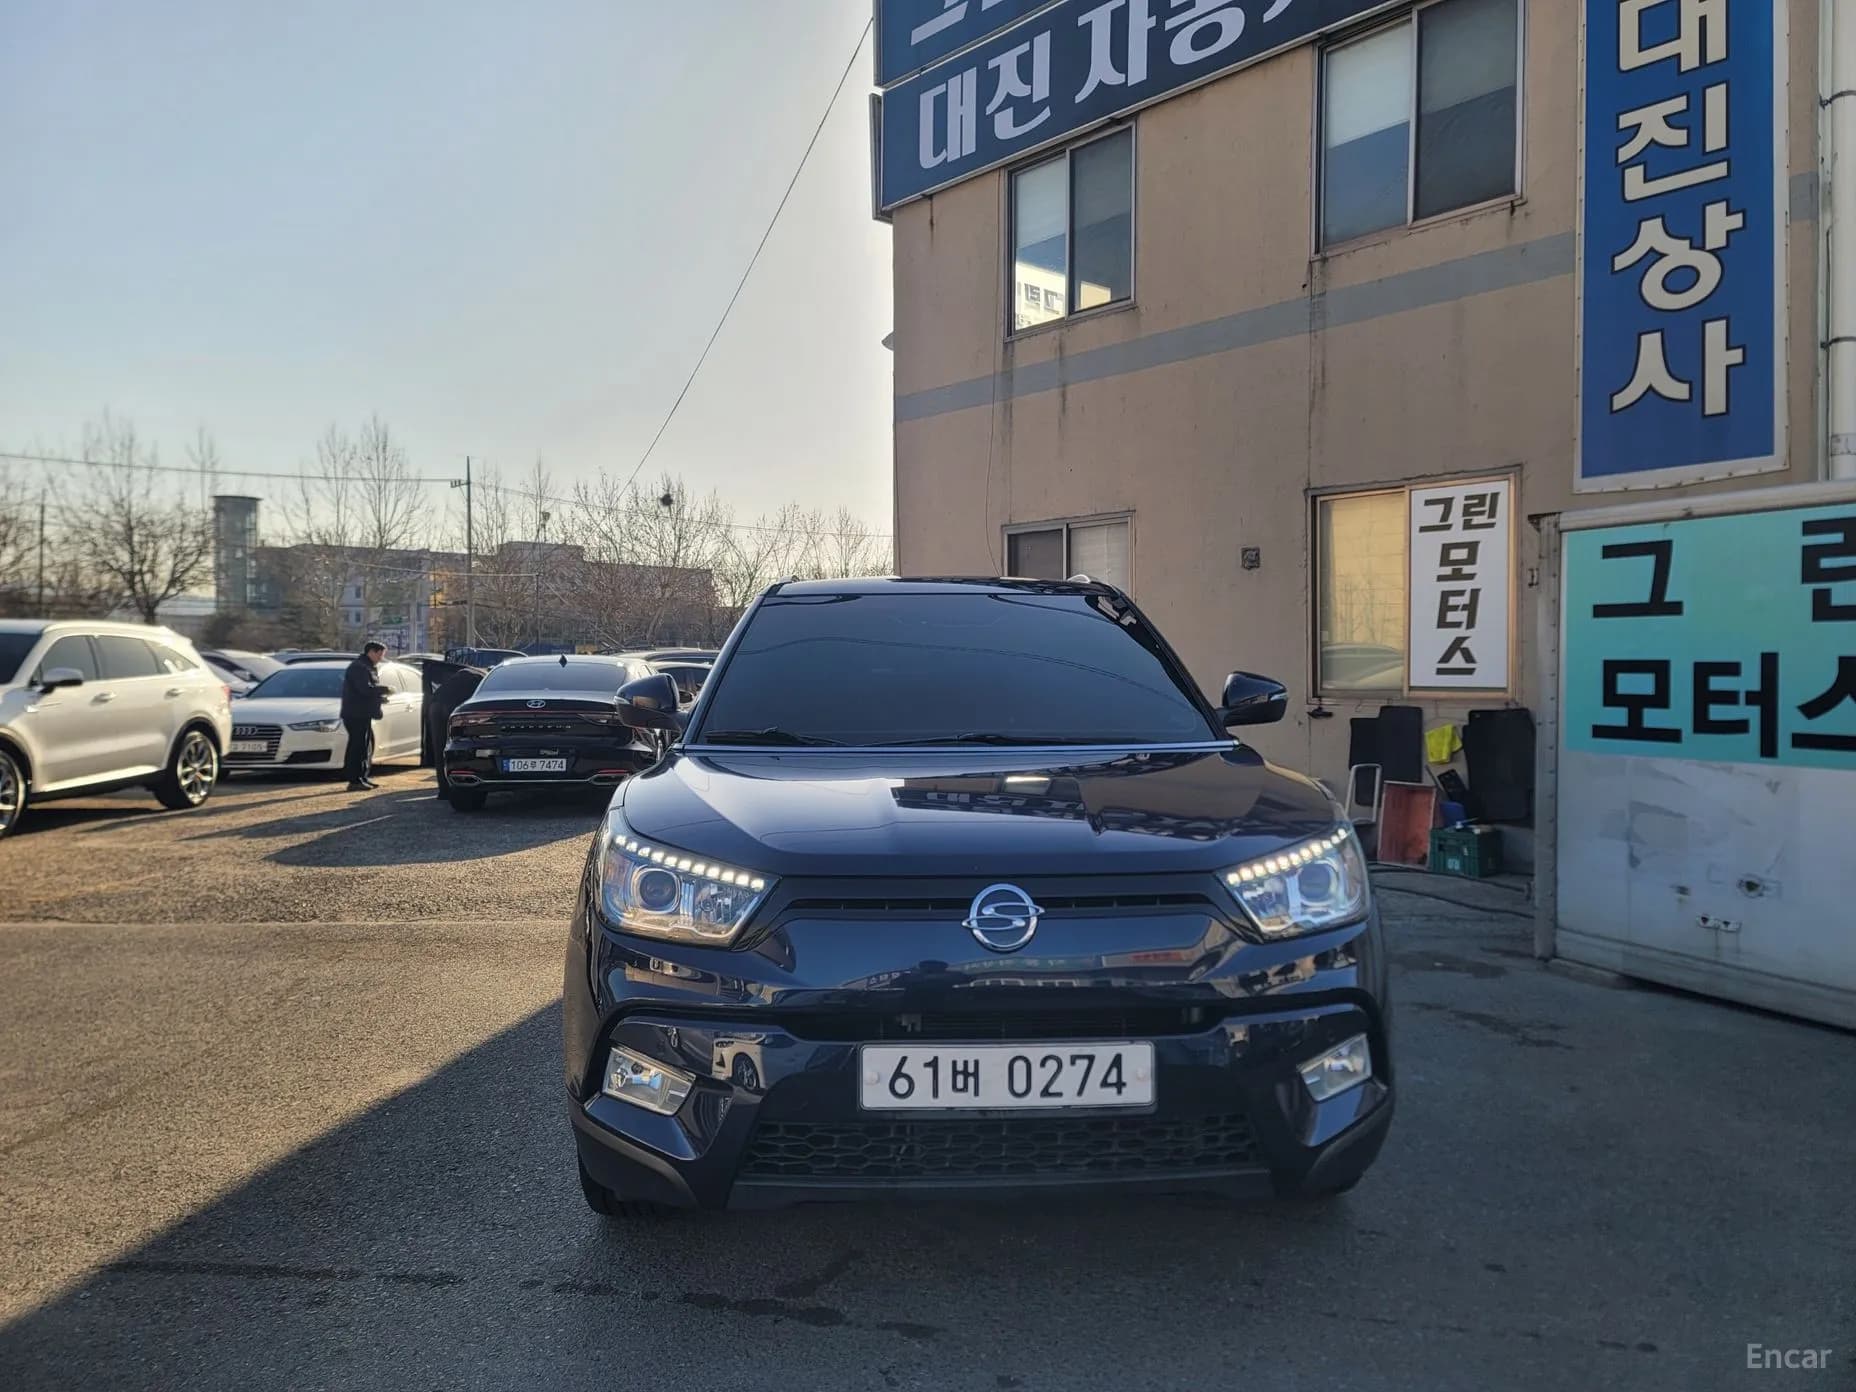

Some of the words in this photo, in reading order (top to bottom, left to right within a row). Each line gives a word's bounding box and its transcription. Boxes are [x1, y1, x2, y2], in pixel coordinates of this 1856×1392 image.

[919, 30, 1051, 169] 대진
[1075, 0, 1293, 104] 자동
[1611, 0, 1746, 416] 대진상사
[1419, 491, 1500, 533] 그린
[1436, 540, 1482, 676] 모터스
[540, 760, 564, 769] 7474
[888, 1055, 980, 1099] 61버
[1008, 1053, 1127, 1099] 0274
